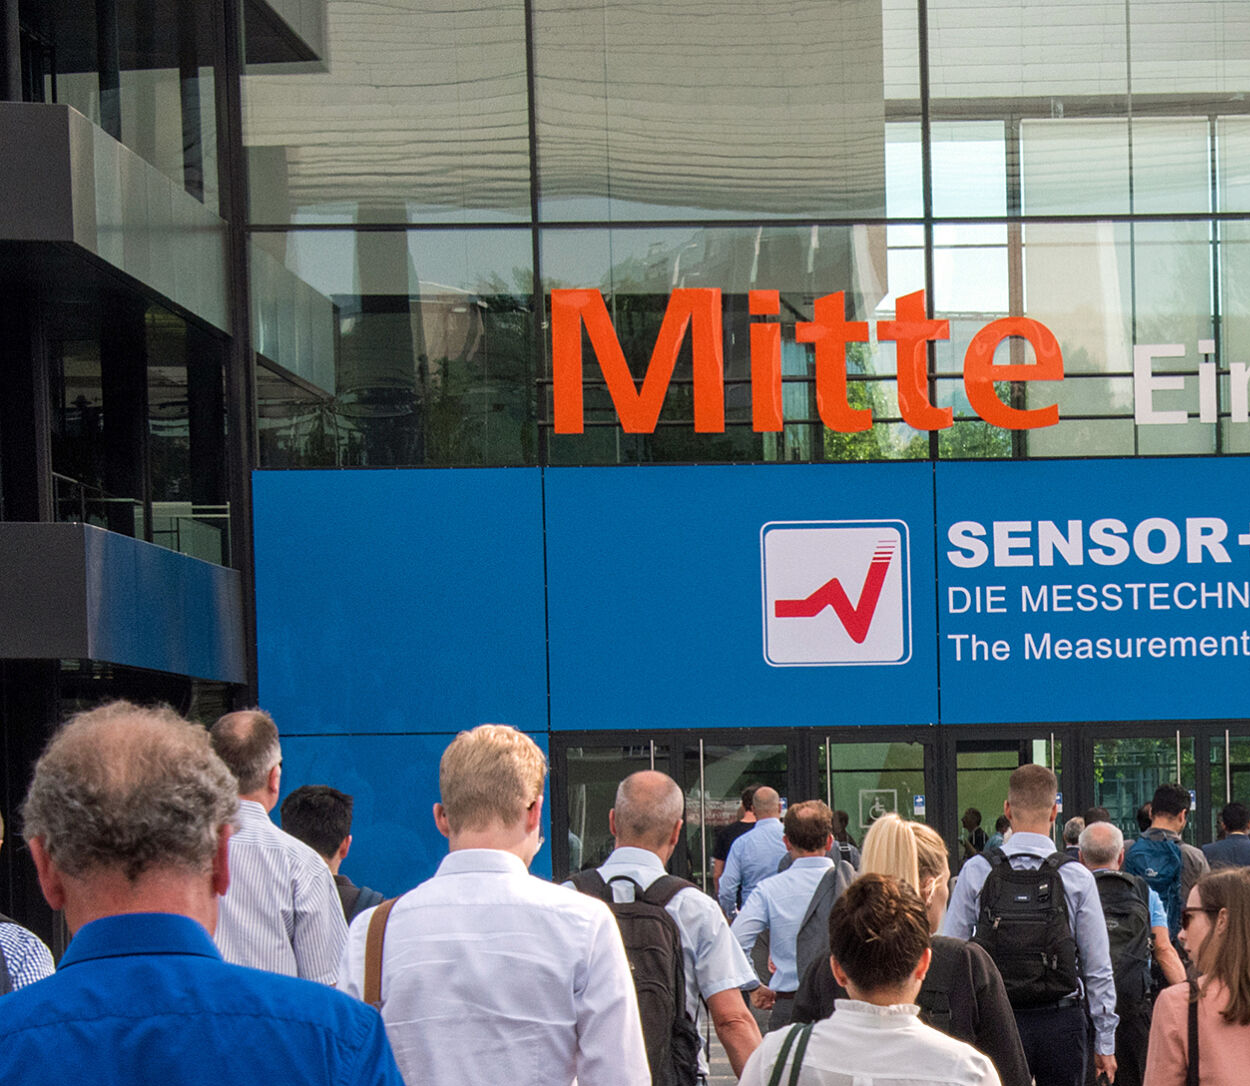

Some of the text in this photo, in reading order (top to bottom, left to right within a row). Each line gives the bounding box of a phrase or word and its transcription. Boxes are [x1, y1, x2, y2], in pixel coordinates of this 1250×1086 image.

[550, 287, 1065, 434] Mitte
[948, 585, 1007, 614] DIE
[947, 634, 1011, 661] The
[1024, 630, 1250, 660] Measurement
